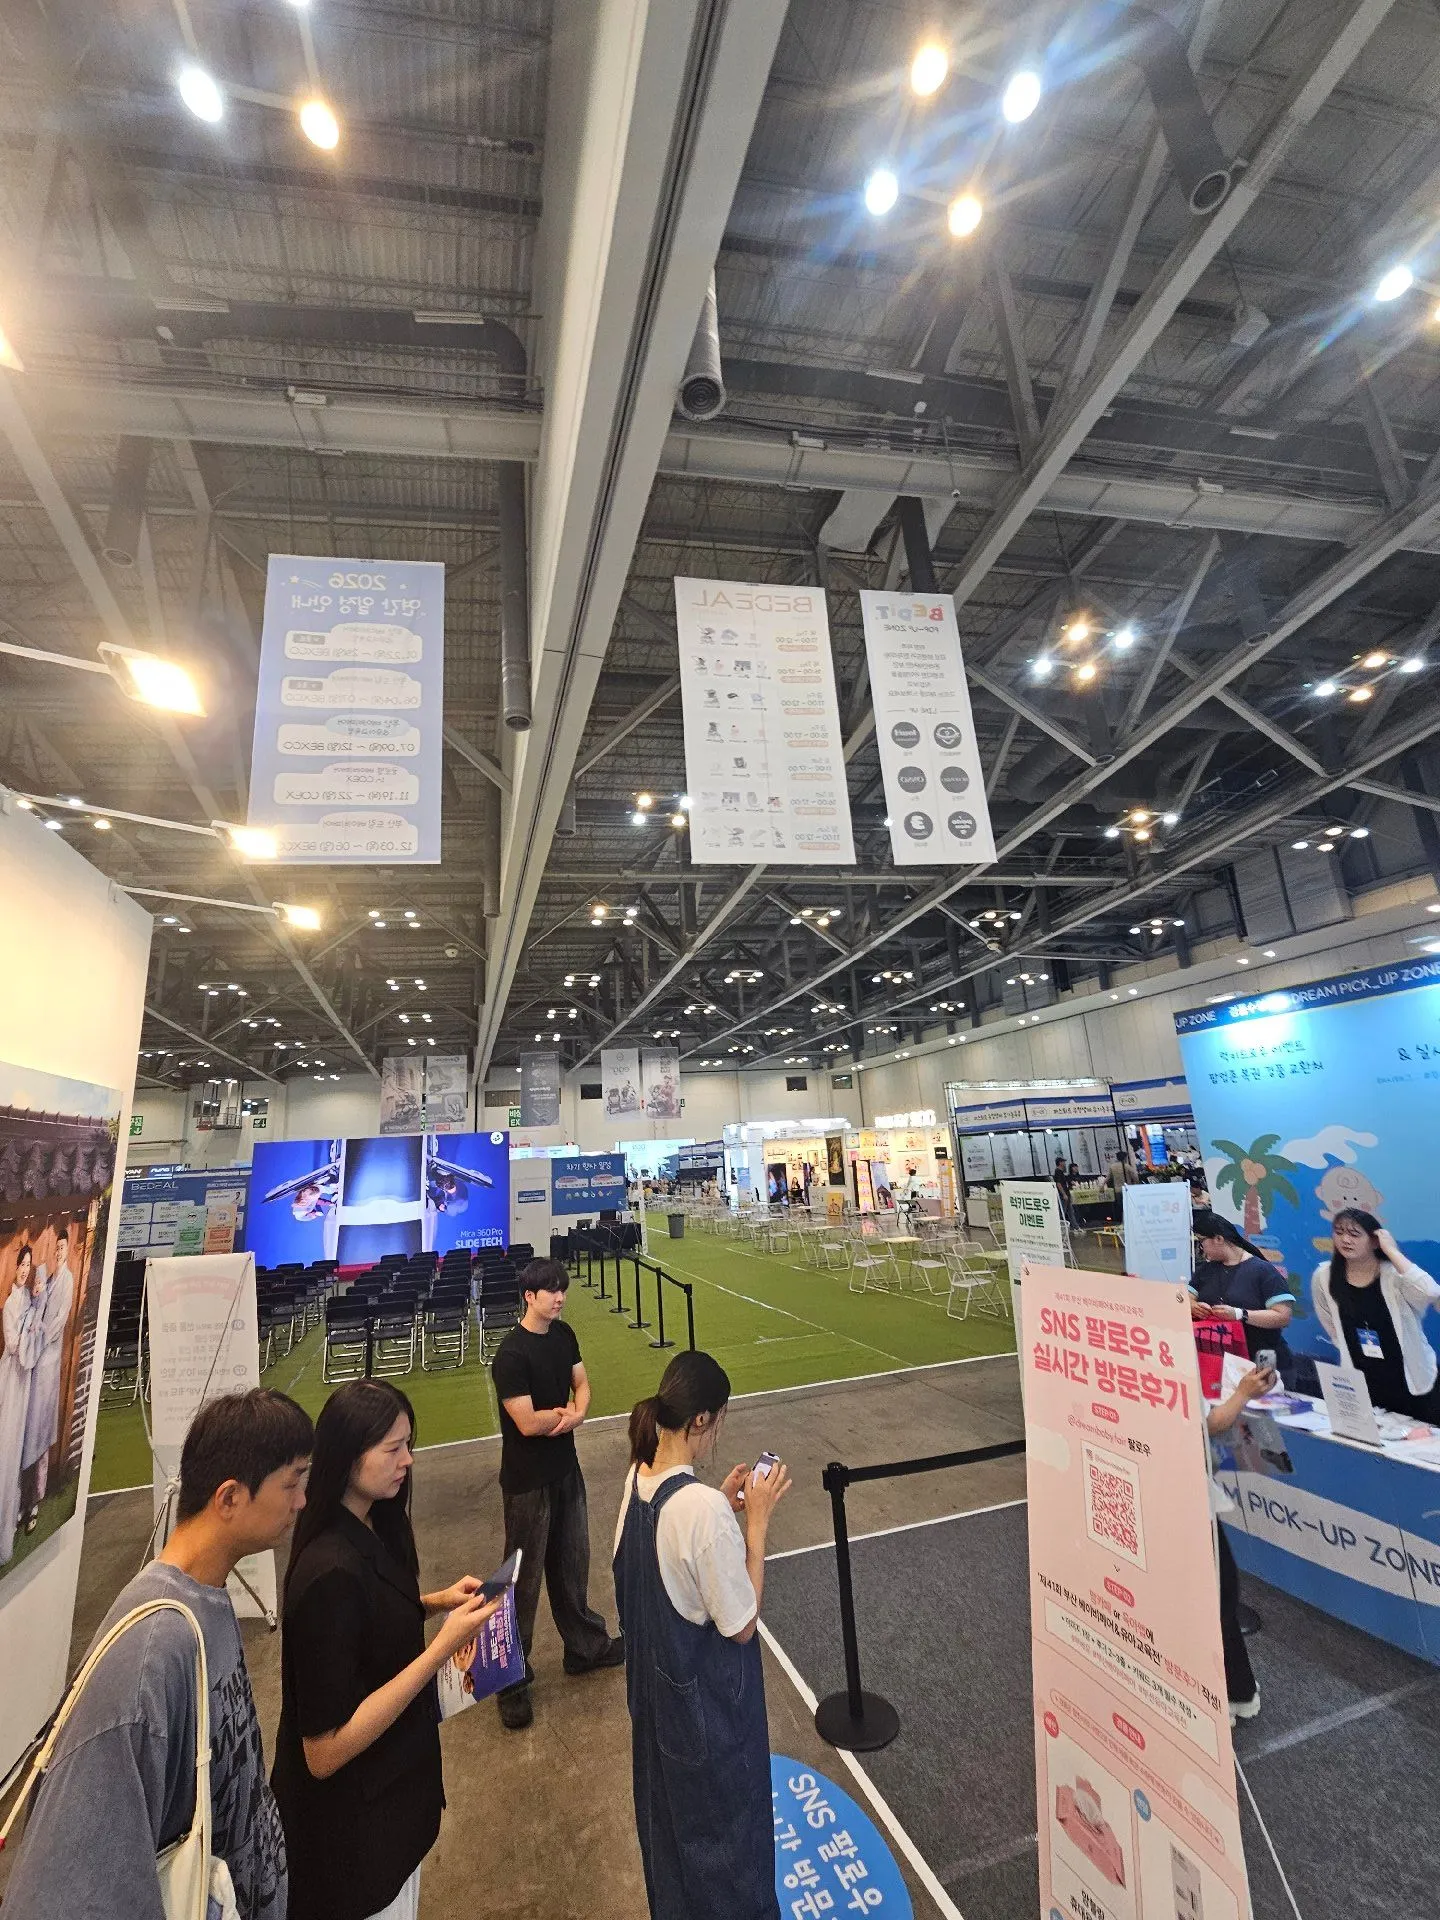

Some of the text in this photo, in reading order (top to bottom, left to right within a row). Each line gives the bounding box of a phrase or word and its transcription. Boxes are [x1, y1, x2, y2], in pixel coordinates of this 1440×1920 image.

[1291, 984, 1339, 1004] DREAM
[1402, 961, 1440, 982] ZONE
[1190, 1011, 1216, 1025] ZONE
[131, 1181, 178, 1191] BEDEAL
[1010, 1197, 1051, 1212] 럭키드로우
[1019, 1213, 1044, 1228] 이벤트
[455, 1237, 503, 1249] SLIDE TECH
[1040, 1307, 1175, 1368] SNS 팔로우 &
[1032, 1341, 1190, 1420] 실시간 방문후기
[1128, 1438, 1152, 1457] 팔로우
[1247, 1491, 1357, 1551] PICK-UP
[1113, 1609, 1121, 1620] or
[1063, 1588, 1078, 1606] 부산
[1164, 1658, 1200, 1693] 방문후기
[1201, 1684, 1222, 1713] 작성!
[788, 1773, 836, 1829] SNS
[818, 1830, 883, 1915] 팔로우
[784, 1858, 838, 1920] 방문
